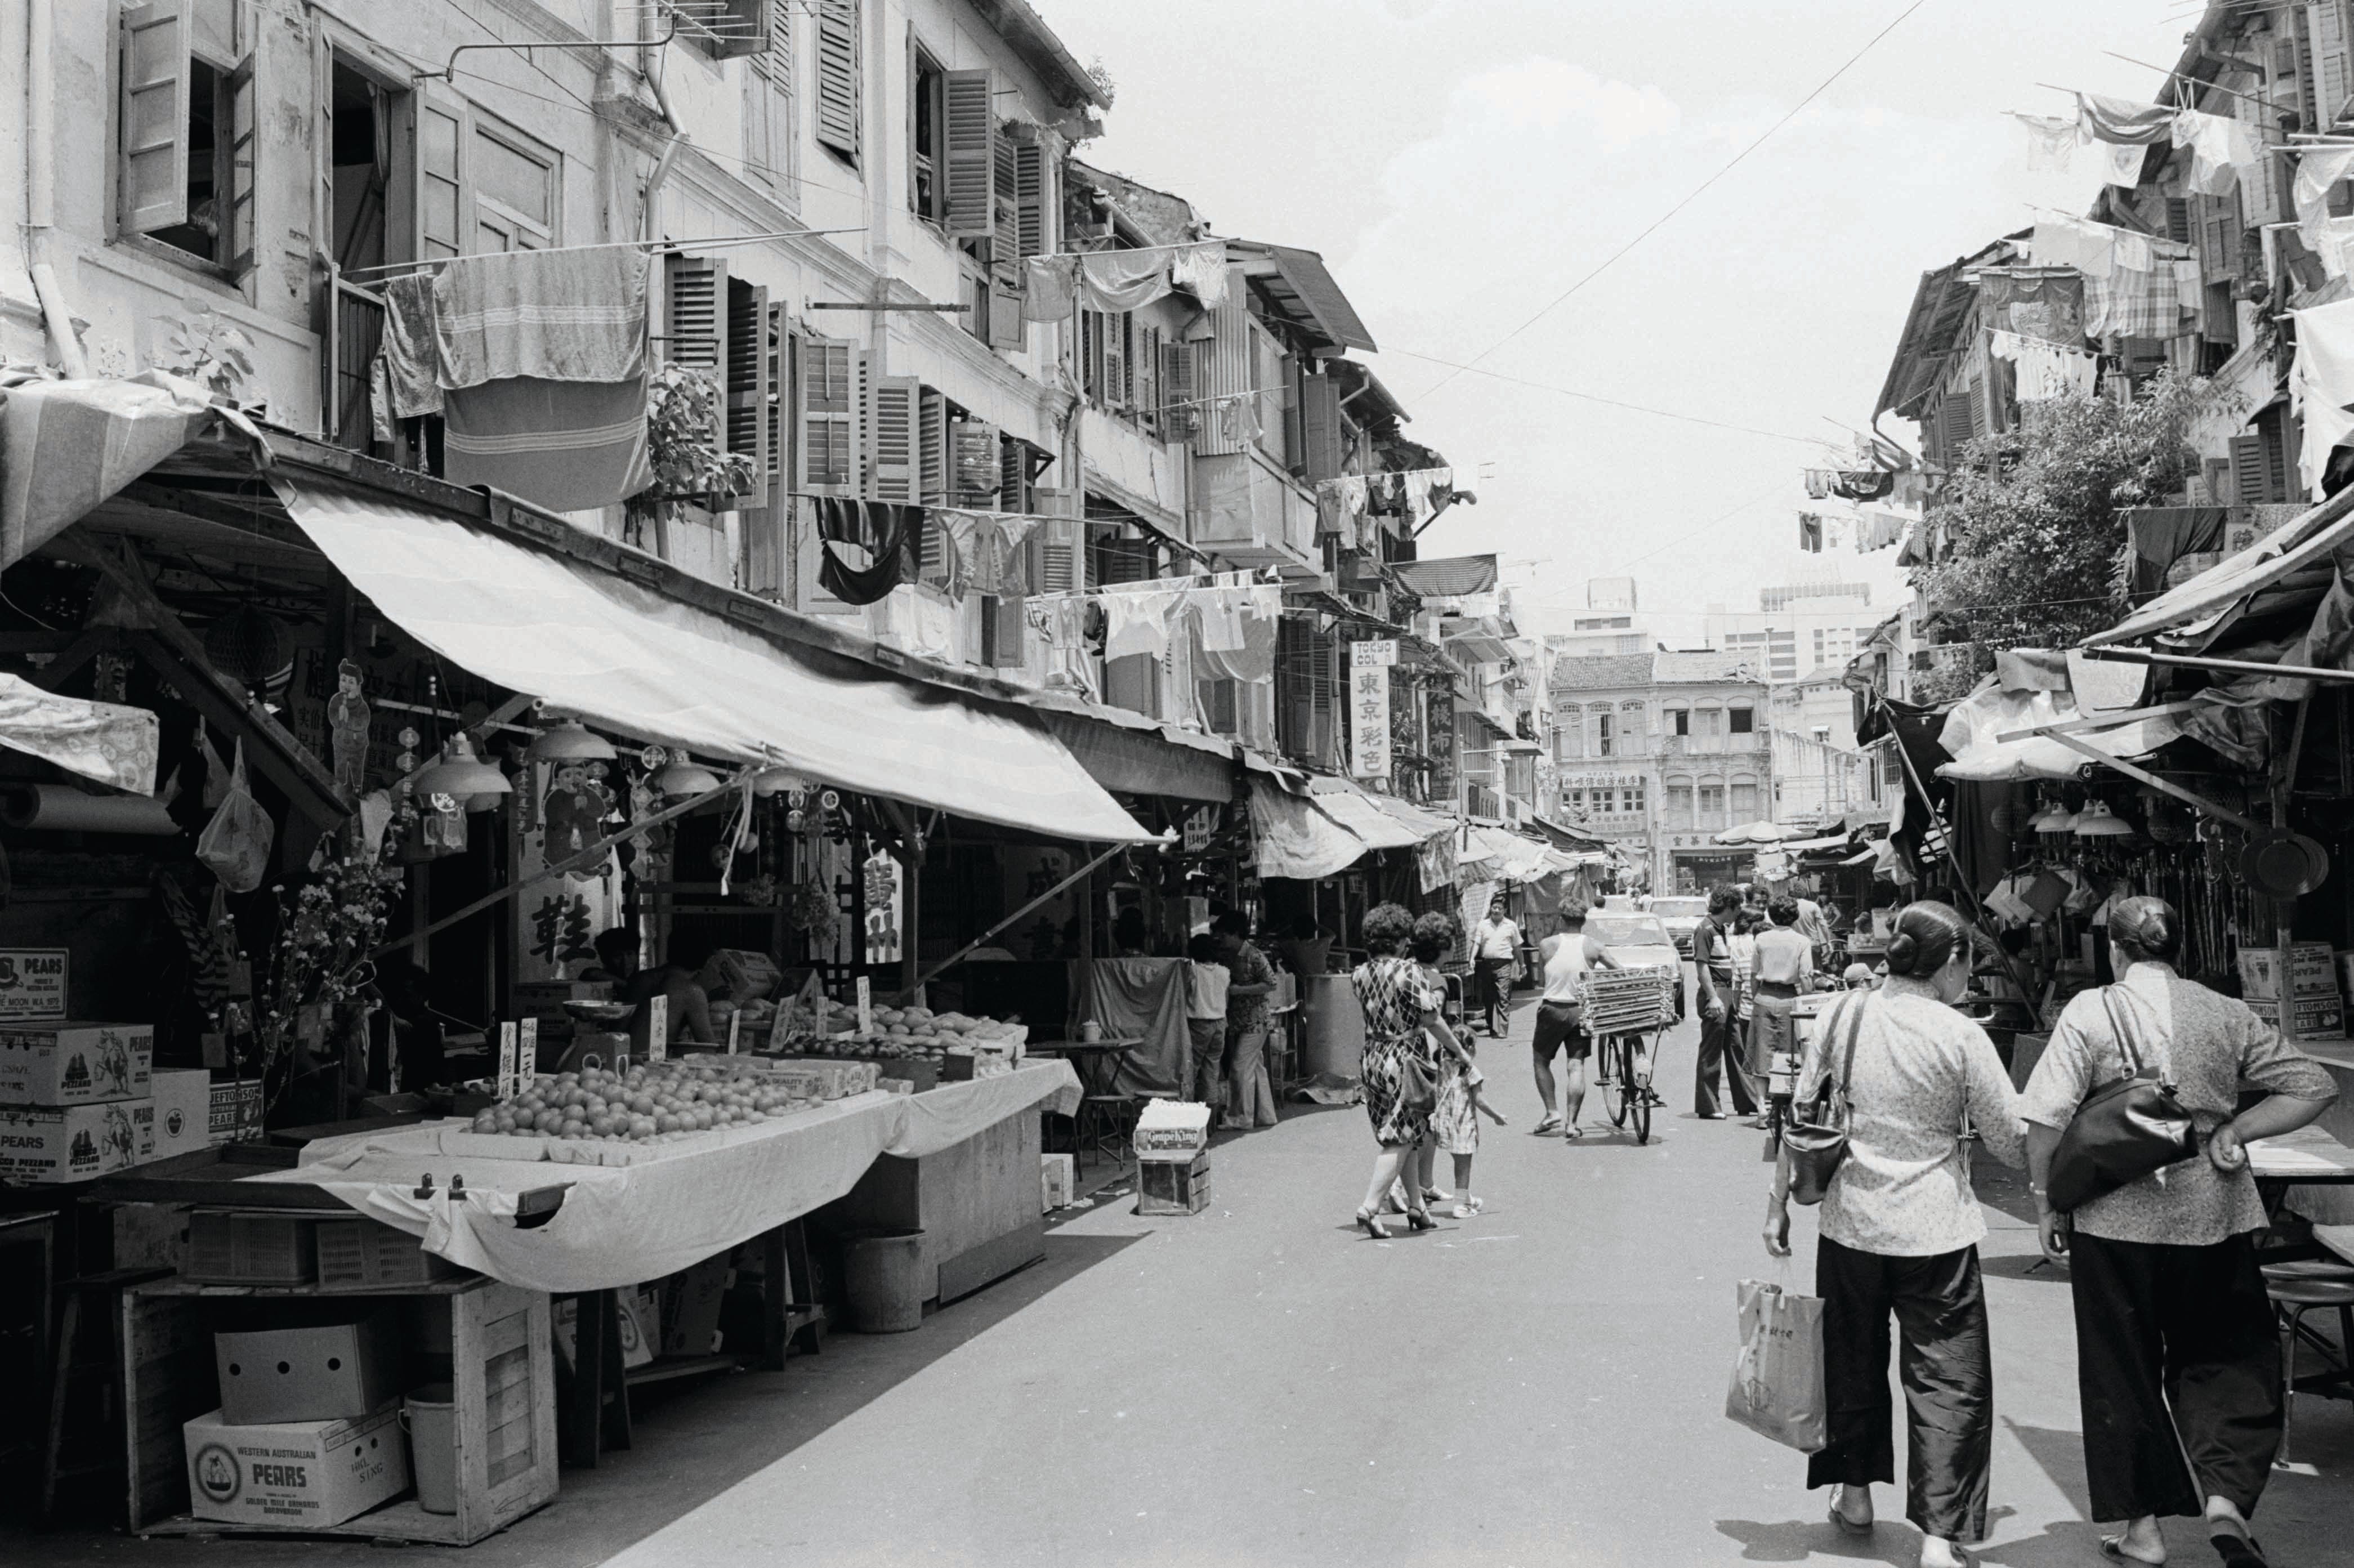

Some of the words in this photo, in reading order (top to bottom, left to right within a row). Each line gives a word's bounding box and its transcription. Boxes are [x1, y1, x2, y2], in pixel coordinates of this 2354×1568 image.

[1357, 642, 1391, 653] TOKYO
[1357, 654, 1391, 665] COLR
[1358, 672, 1383, 772] 東京彩色
[530, 894, 597, 964] 鞋
[25, 958, 62, 975] PEARS
[129, 1035, 153, 1052] PEARS
[210, 1088, 257, 1104] JEFTOSO
[134, 1106, 154, 1124] PEARS
[209, 1113, 237, 1125] PEARS
[1, 1135, 44, 1149] PEARS
[19, 1158, 57, 1168] PEZZANO
[70, 1155, 100, 1167] PEZZANO
[237, 1446, 270, 1457] WESTERN
[272, 1448, 316, 1459] AUSTRALIAN
[253, 1463, 307, 1487] PEARS
[288, 1500, 320, 1508] ORCHARDS
